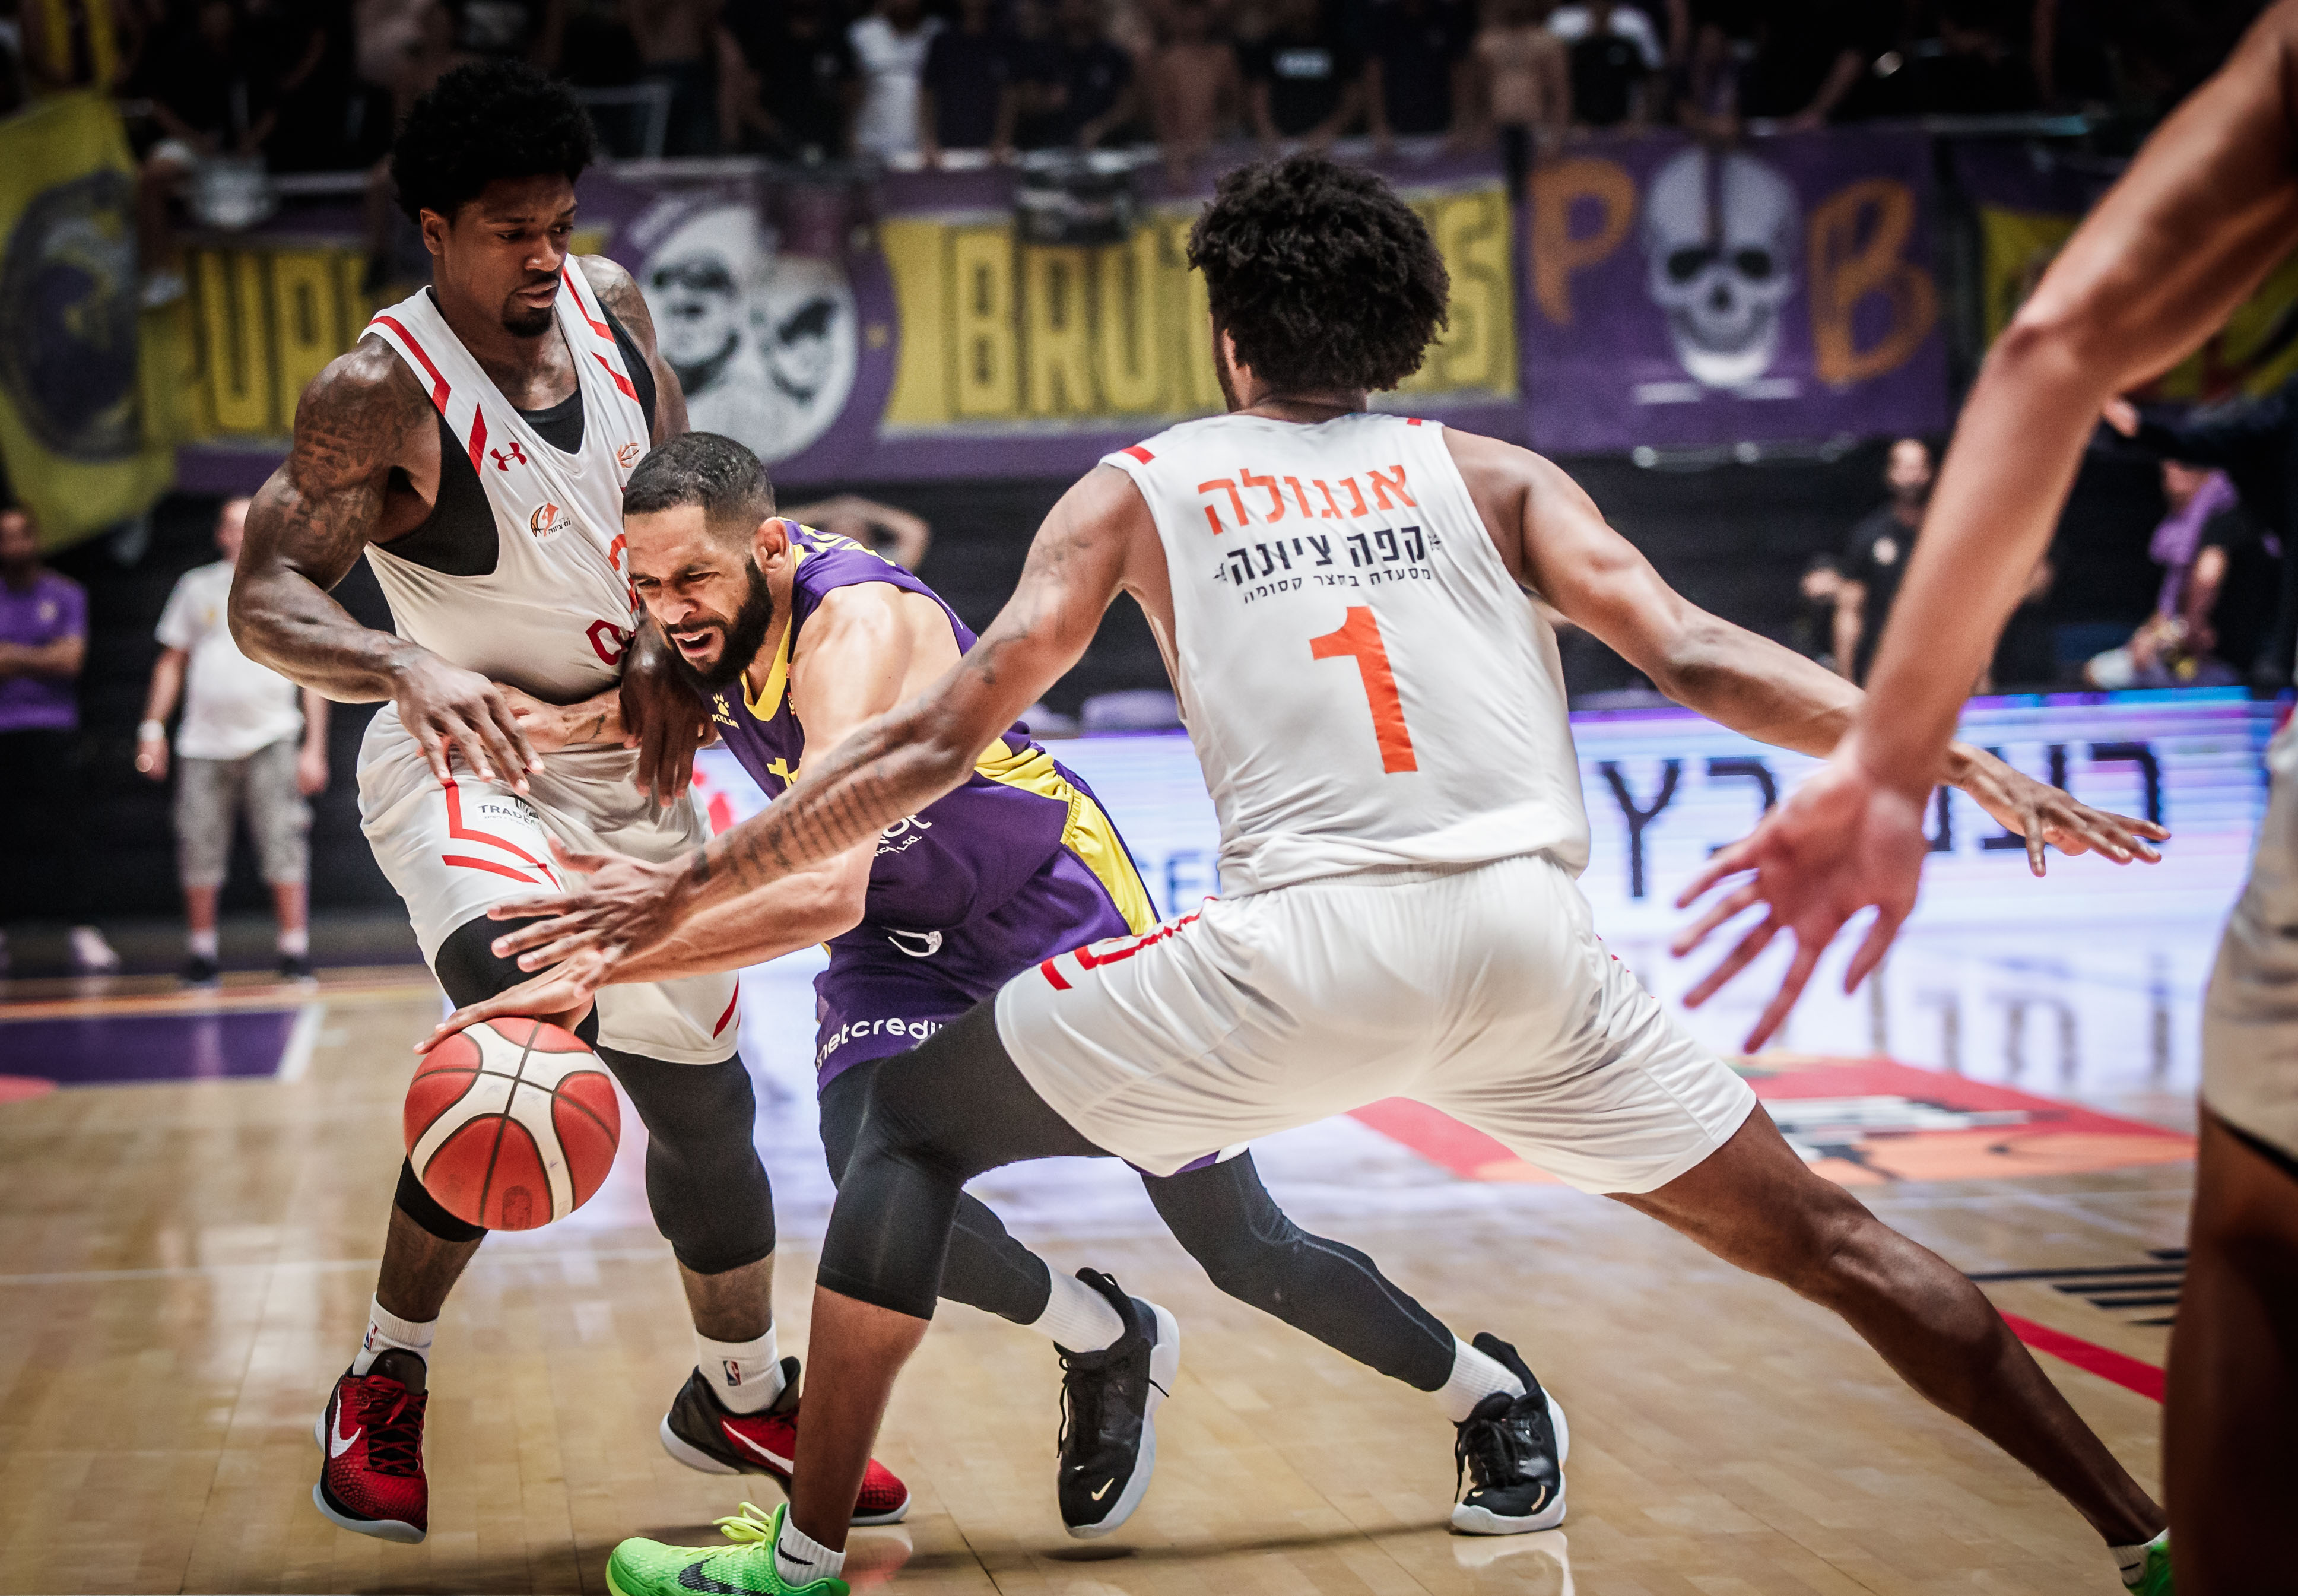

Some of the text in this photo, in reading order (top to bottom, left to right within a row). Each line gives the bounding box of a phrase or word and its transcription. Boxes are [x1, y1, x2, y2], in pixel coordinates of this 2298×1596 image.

[1198, 465, 1418, 535] אנגולה
[1226, 526, 1426, 586] קפה ציונה
[1369, 567, 1432, 586] מסעדה
[1244, 577, 1302, 604] קסומה
[1309, 606, 1418, 774] 1
